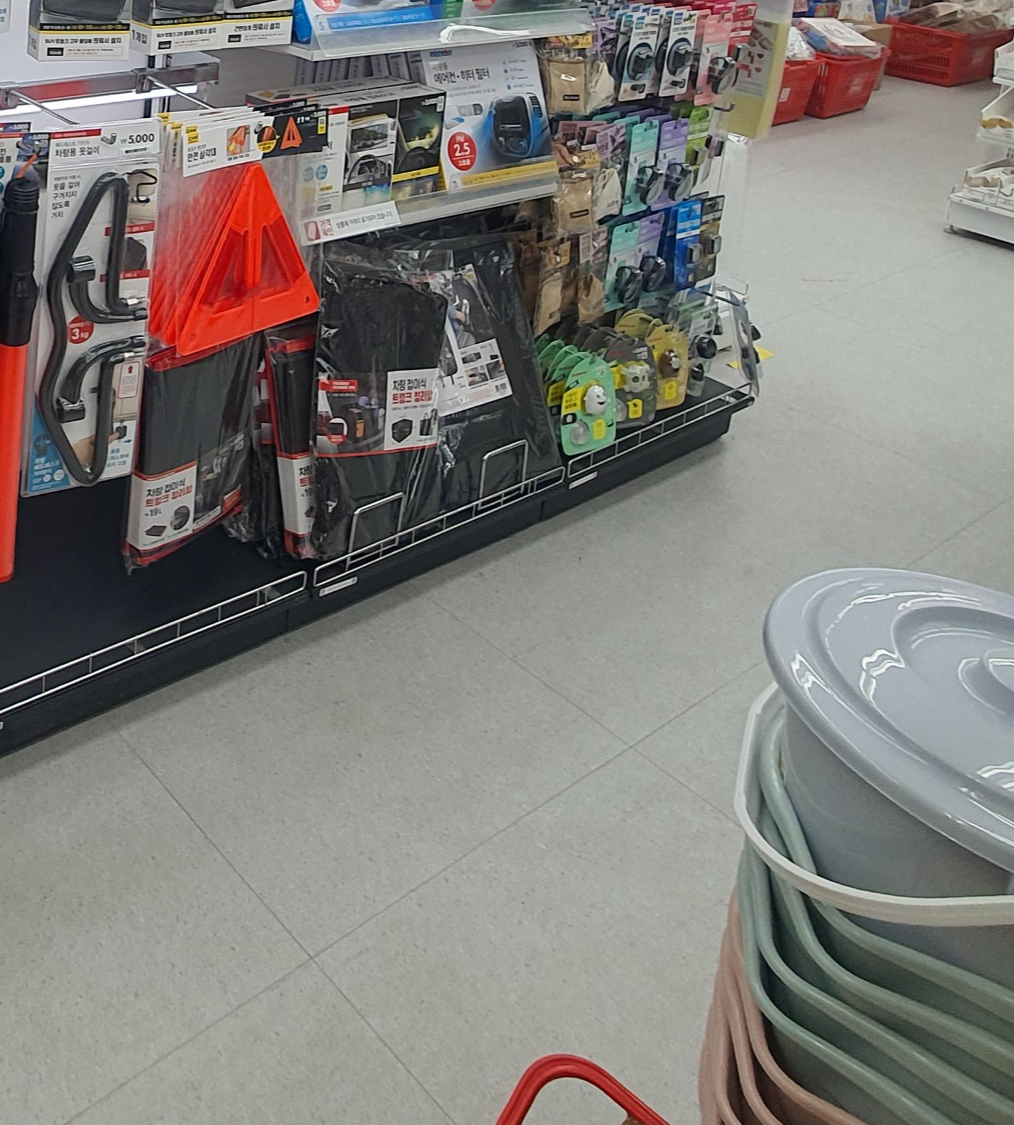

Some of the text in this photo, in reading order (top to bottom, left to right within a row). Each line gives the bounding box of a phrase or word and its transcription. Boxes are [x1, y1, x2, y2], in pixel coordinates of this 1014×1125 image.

[474, 67, 491, 80] 필터
[128, 133, 155, 144] 5,000
[55, 145, 100, 158] 차량용 옷걸이
[453, 143, 471, 155] 2.5
